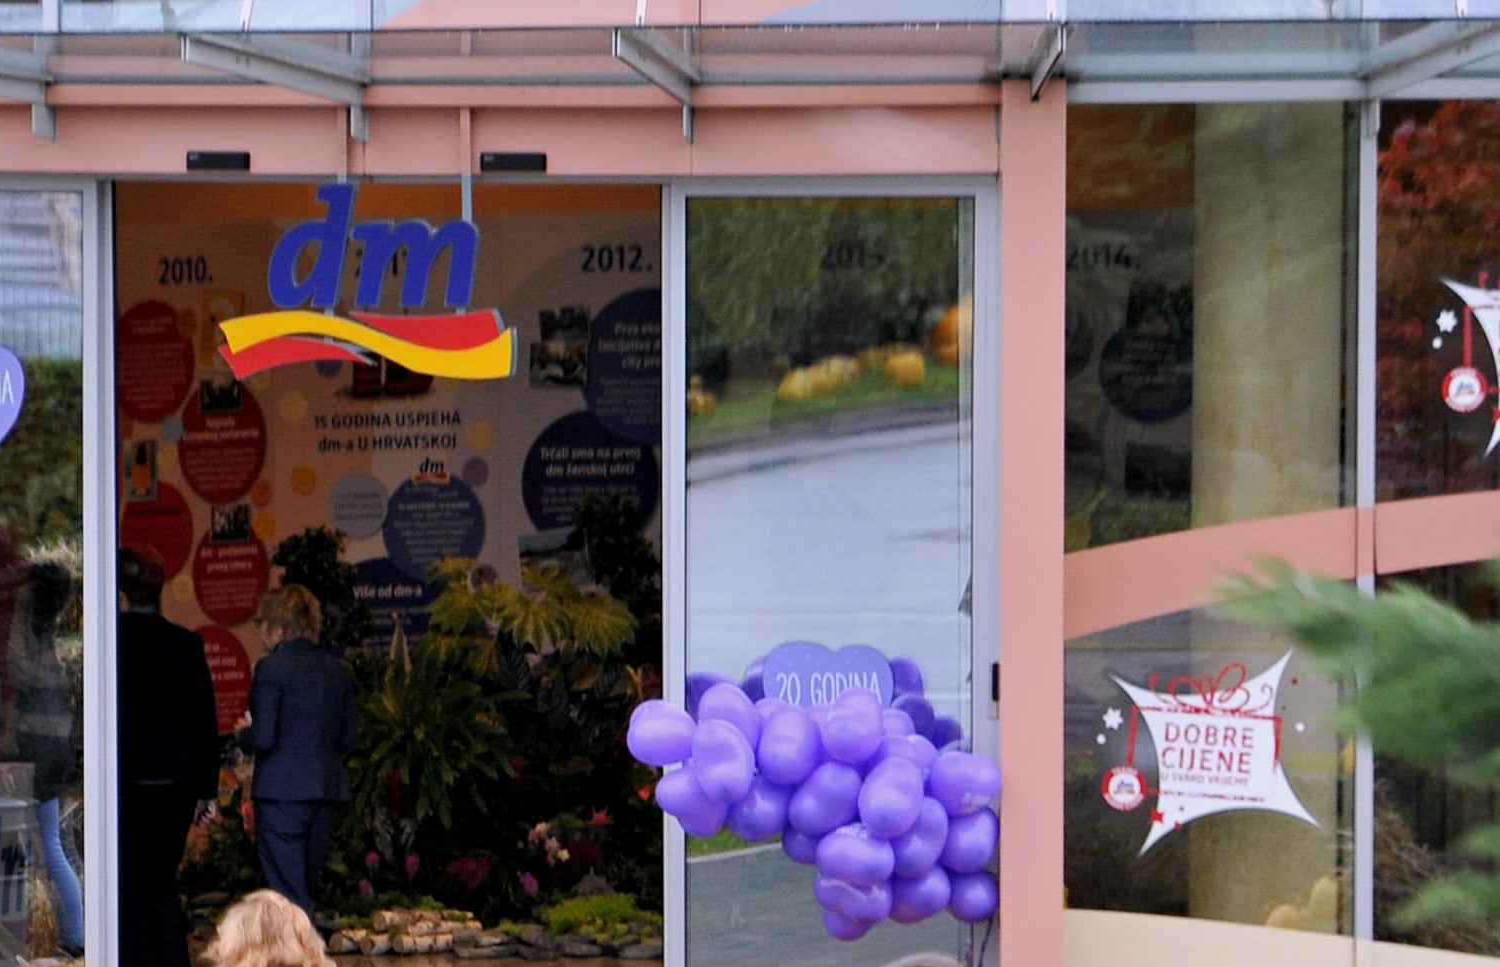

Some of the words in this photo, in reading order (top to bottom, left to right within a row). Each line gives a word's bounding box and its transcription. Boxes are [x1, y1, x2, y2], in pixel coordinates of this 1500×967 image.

[267, 183, 480, 310] dm
[580, 244, 653, 273] 2012.
[158, 256, 213, 285] 2010.
[314, 413, 328, 429] 15
[331, 412, 391, 429] GODINA
[318, 436, 354, 453] dm-a
[358, 437, 368, 451] U
[372, 433, 457, 450] HRVATSKOJ
[419, 456, 445, 473] dm
[353, 585, 376, 599] Više
[378, 585, 392, 598] od
[394, 584, 422, 598] dm-a
[775, 672, 803, 706] 20
[1164, 721, 1255, 749] DOBRE
[1161, 747, 1252, 774] CIJENE
